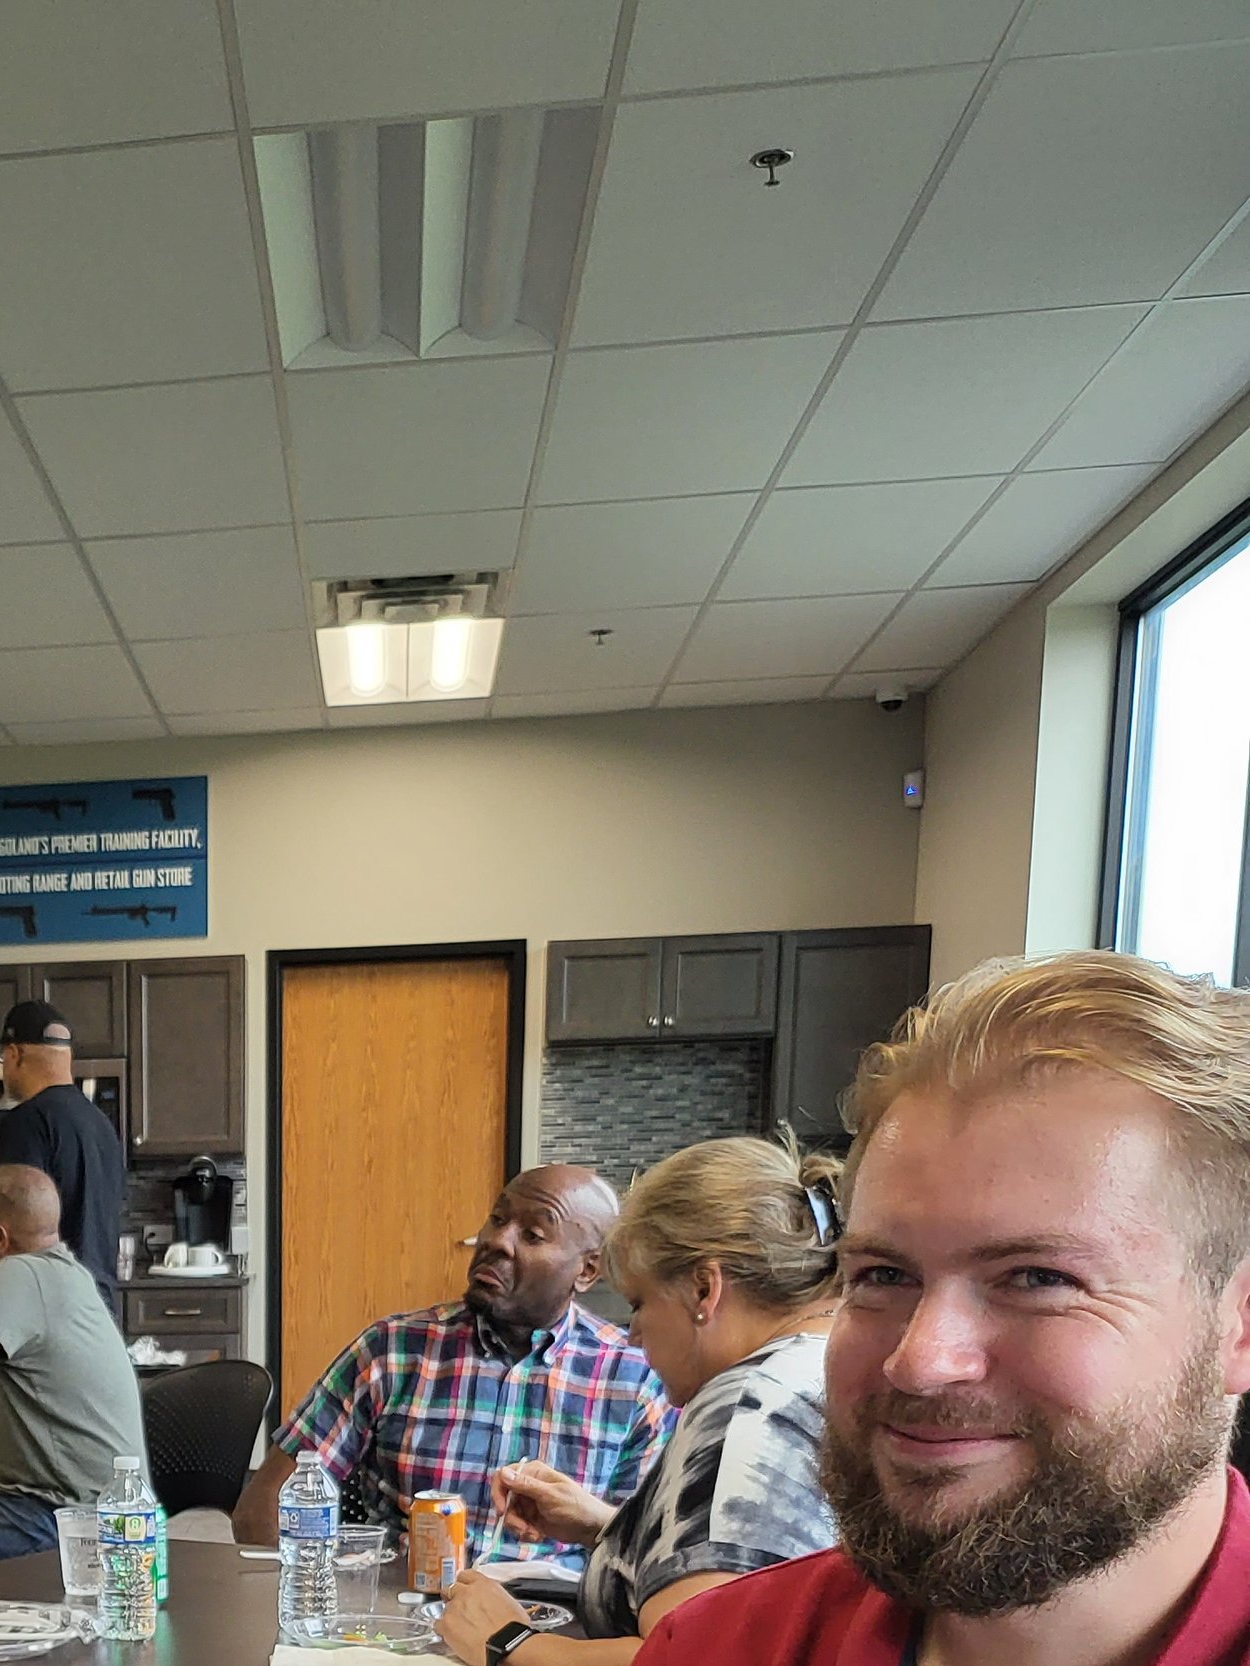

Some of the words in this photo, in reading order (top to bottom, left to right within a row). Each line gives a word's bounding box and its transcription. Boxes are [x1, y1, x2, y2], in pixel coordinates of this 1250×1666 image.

[51, 834, 98, 854] PREMIER
[100, 831, 150, 852] TRAINING
[151, 828, 202, 850] FACILITY,
[33, 873, 69, 893] RANGE
[70, 872, 93, 891] AND
[94, 870, 130, 889] RETAIL
[132, 868, 156, 887] GUN
[157, 866, 193, 887] STORE
